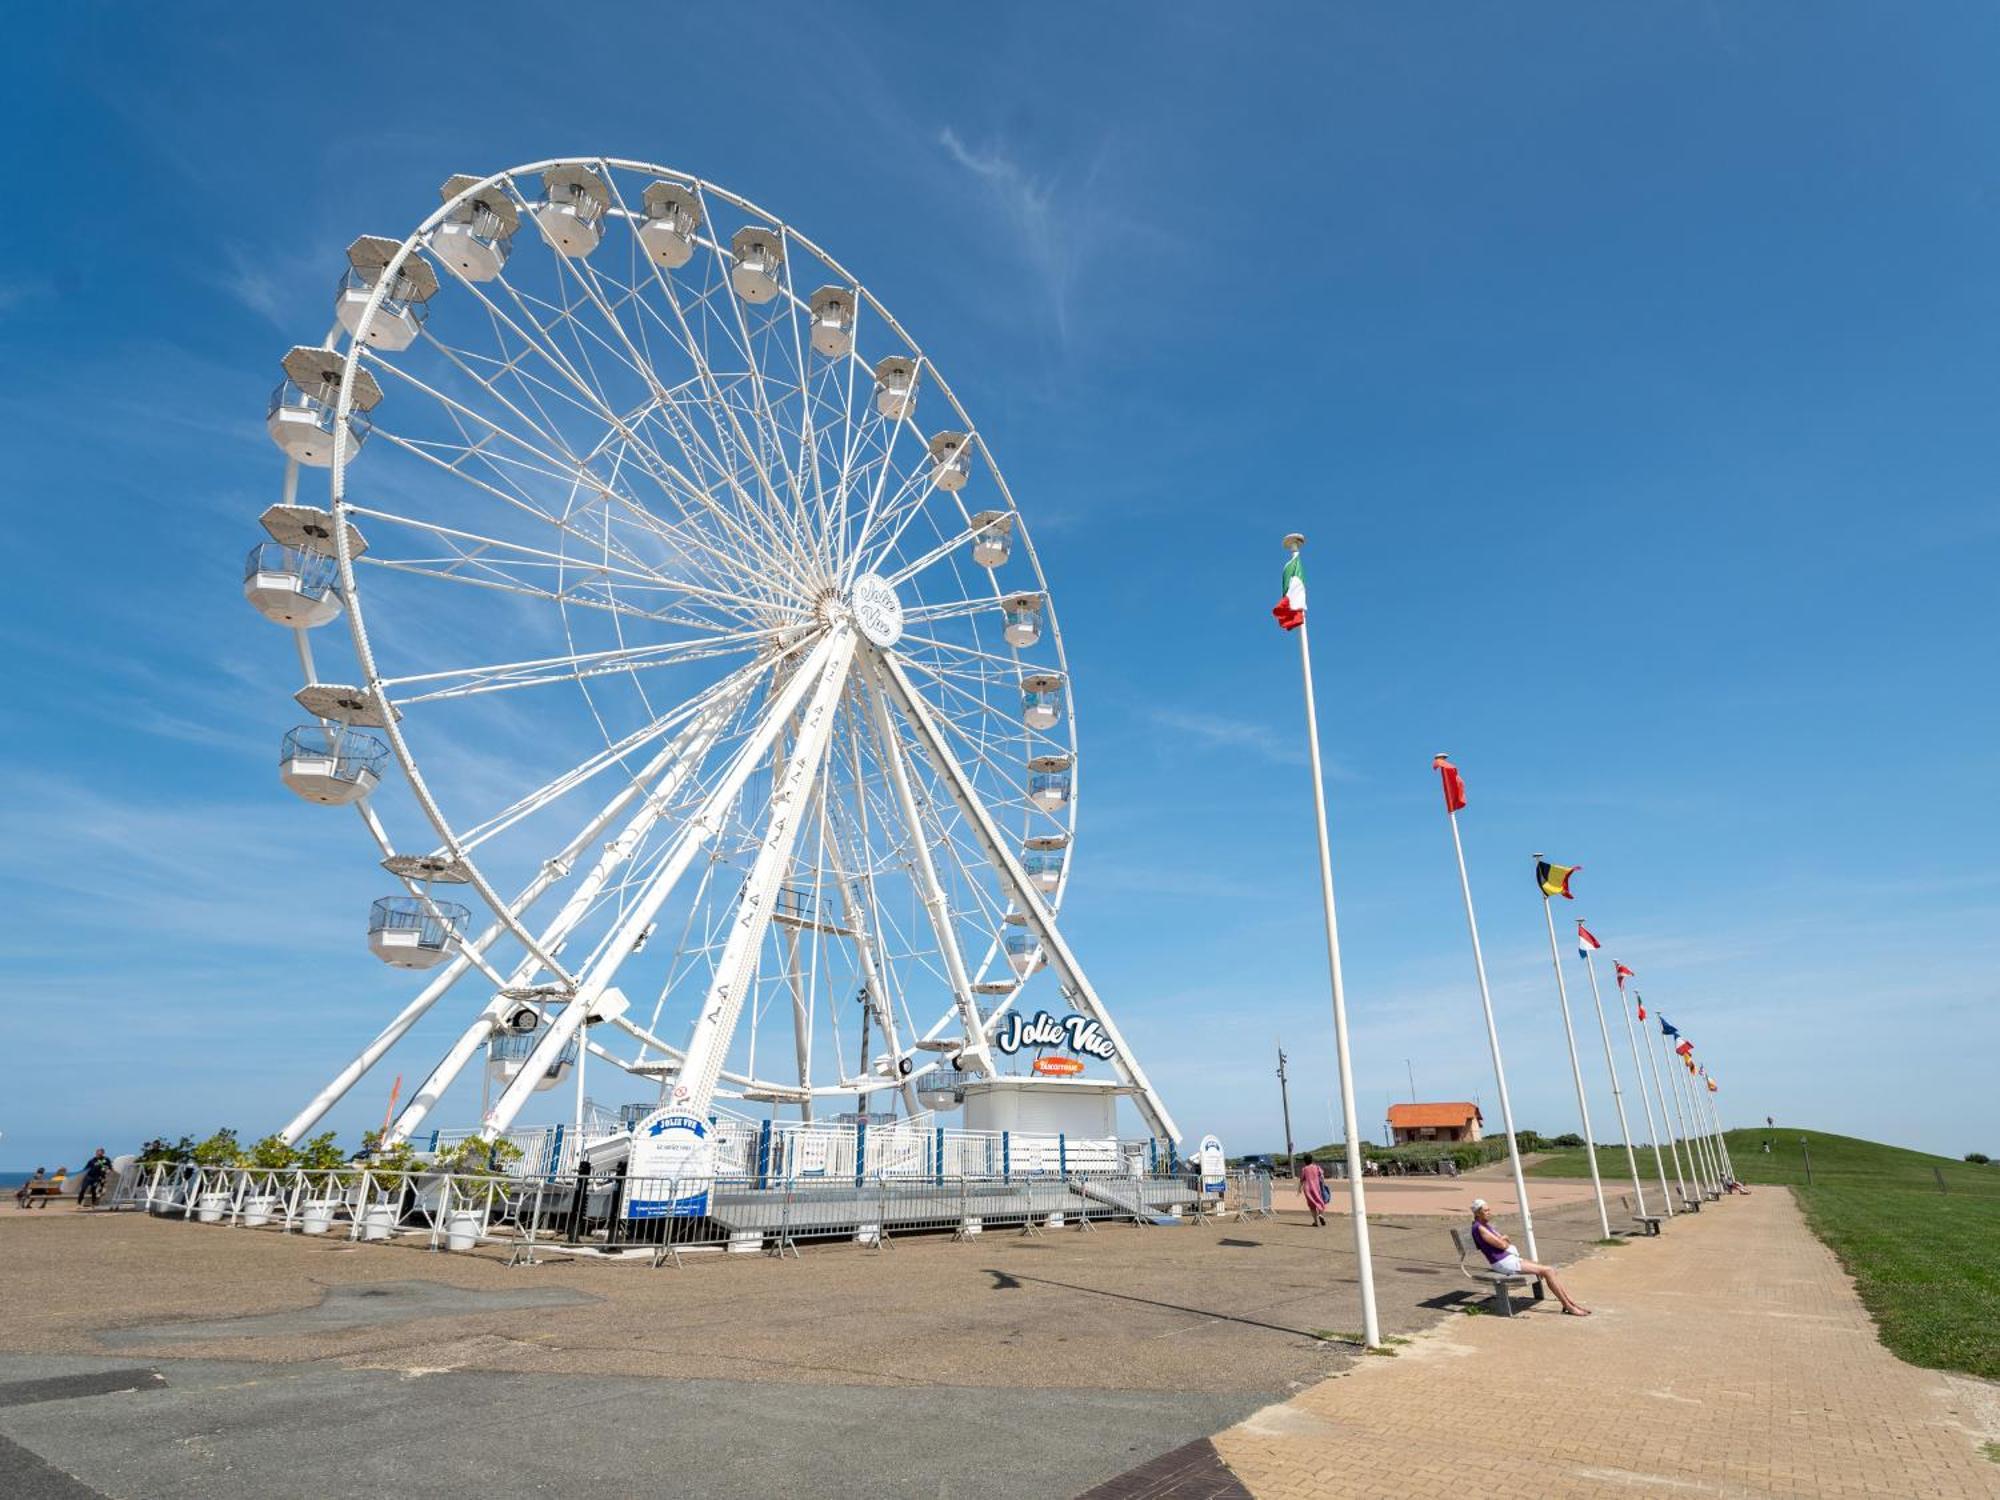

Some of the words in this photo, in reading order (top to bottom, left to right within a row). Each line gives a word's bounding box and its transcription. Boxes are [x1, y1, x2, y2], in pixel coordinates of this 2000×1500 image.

[861, 580, 896, 612] Jolie
[861, 604, 890, 637] Vue
[998, 1011, 1067, 1053] Jolie
[1064, 1014, 1116, 1059] Vue
[660, 1118, 682, 1129] JOLIE
[683, 1117, 698, 1129] VUE
